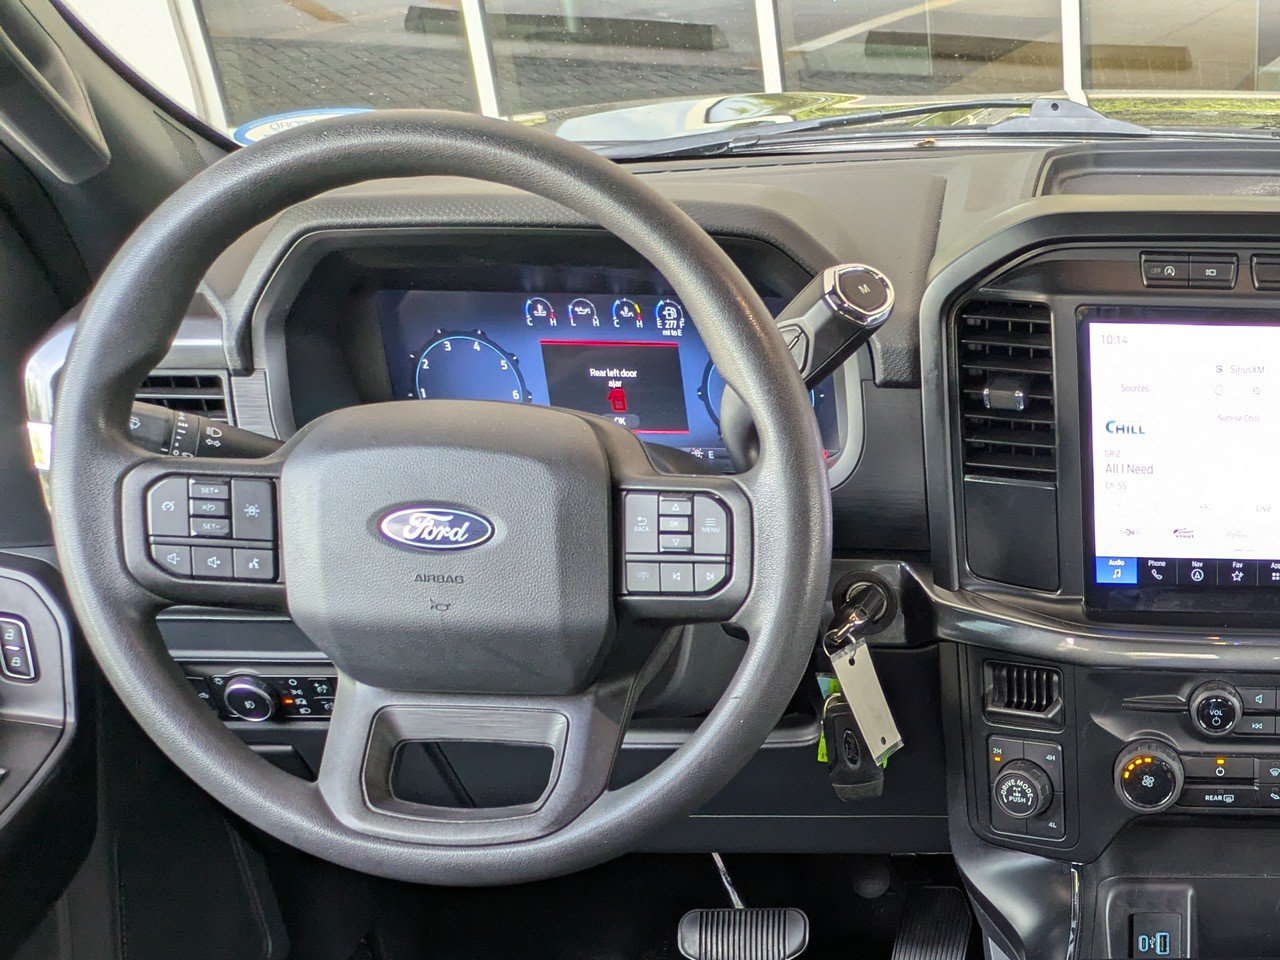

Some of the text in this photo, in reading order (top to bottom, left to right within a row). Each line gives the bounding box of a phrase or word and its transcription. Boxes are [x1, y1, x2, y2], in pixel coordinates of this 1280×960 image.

[858, 284, 871, 295] M
[526, 317, 533, 326] C
[550, 318, 557, 326] H
[571, 318, 576, 326] L
[593, 318, 600, 327] H
[613, 319, 620, 327] C
[636, 320, 643, 328] H
[657, 320, 662, 328] E
[665, 320, 677, 328] 277
[1101, 334, 1128, 345] 10:14
[444, 341, 451, 351] 3
[473, 341, 480, 351] 4
[421, 359, 429, 369] 2
[500, 361, 508, 370] 5
[590, 368, 637, 378] Rear left door
[1230, 364, 1265, 374] SiriusXM
[608, 379, 622, 388] ajar
[1120, 384, 1149, 392] Sources
[420, 388, 426, 398] 1
[512, 390, 519, 400] 6
[614, 416, 626, 426] OK
[1218, 414, 1243, 422] Sunrise
[1105, 420, 1145, 434] CHILL
[709, 450, 714, 459] E
[1105, 463, 1118, 474] All
[1127, 464, 1154, 475] Need
[201, 486, 219, 494] SET+
[403, 512, 470, 542] Ford
[1148, 559, 1166, 567] Phone
[1233, 561, 1243, 569] Fav
[414, 573, 464, 584] AIRBAG
[1000, 778, 1034, 798] DRIVE MODE
[1008, 795, 1026, 803] PUSH
[1048, 821, 1057, 829] 4L
